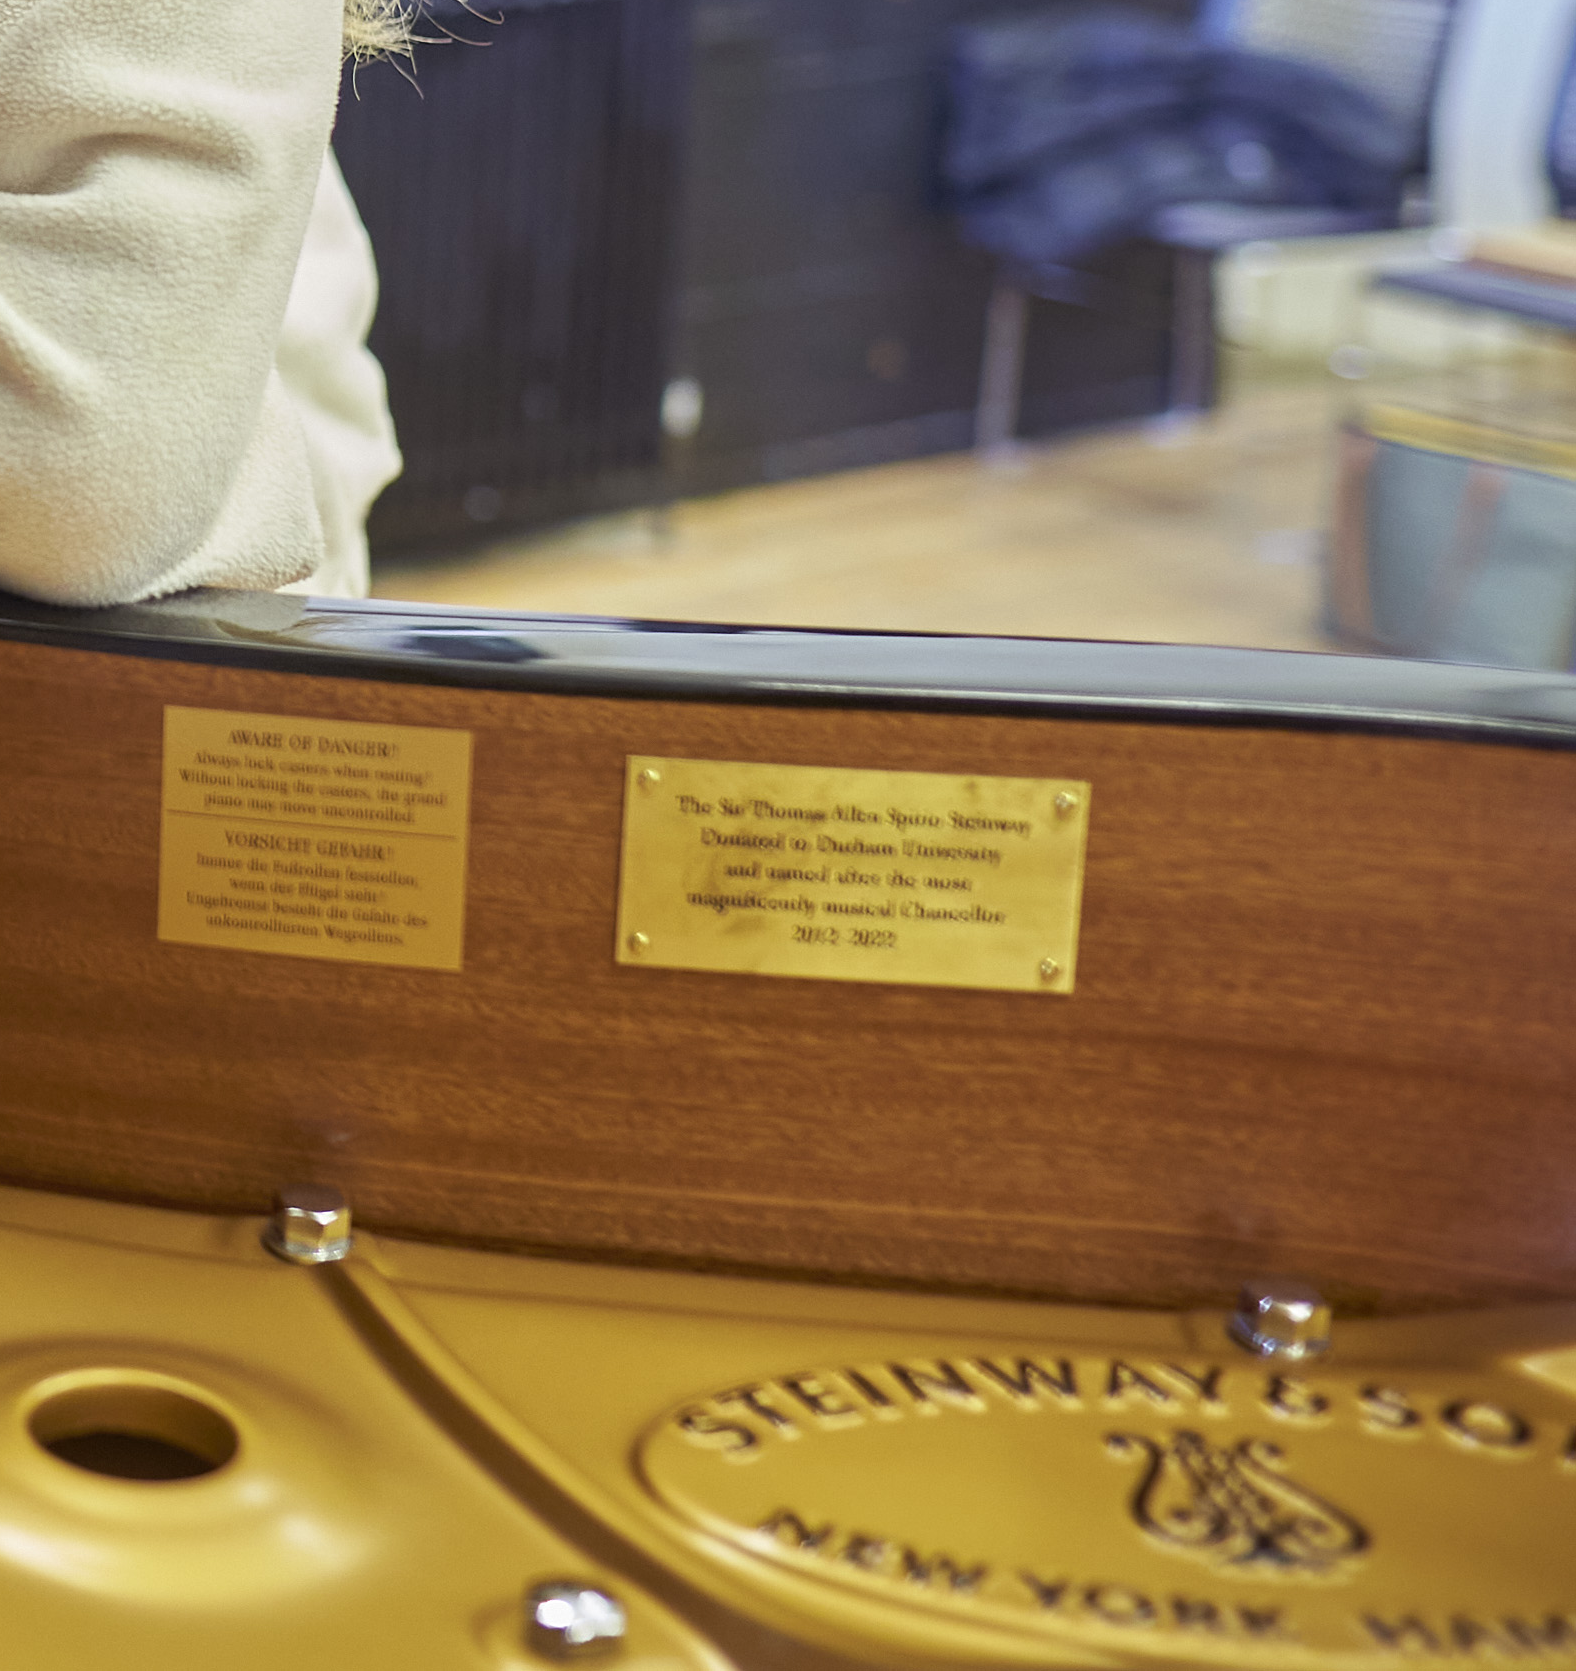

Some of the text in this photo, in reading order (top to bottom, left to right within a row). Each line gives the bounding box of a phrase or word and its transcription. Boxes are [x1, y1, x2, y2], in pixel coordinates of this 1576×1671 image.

[229, 730, 398, 758] AWARE OF DANGER!
[194, 751, 240, 768] Always
[244, 755, 274, 770] lock
[179, 768, 231, 787] Without
[236, 773, 288, 795] locking
[293, 780, 314, 795] the
[403, 789, 446, 806] grand
[204, 792, 242, 807] piano
[247, 797, 274, 813] may
[280, 801, 316, 814] move
[676, 795, 712, 814] The
[717, 797, 745, 817] Sir
[750, 799, 826, 822] Thomas
[948, 810, 1031, 840] Steinway
[224, 830, 311, 855] VORSICHT
[701, 828, 785, 851] Donated
[816, 834, 896, 856] Durham
[903, 838, 1001, 869] University
[724, 861, 762, 880] and
[766, 865, 829, 884] named
[887, 869, 917, 889] the
[923, 876, 972, 892] most
[823, 899, 897, 918] musical
[679, 1358, 1576, 1462] STEINWAY & SO
[754, 1508, 992, 1596] NEW
[1014, 1568, 1285, 1636] YORK
